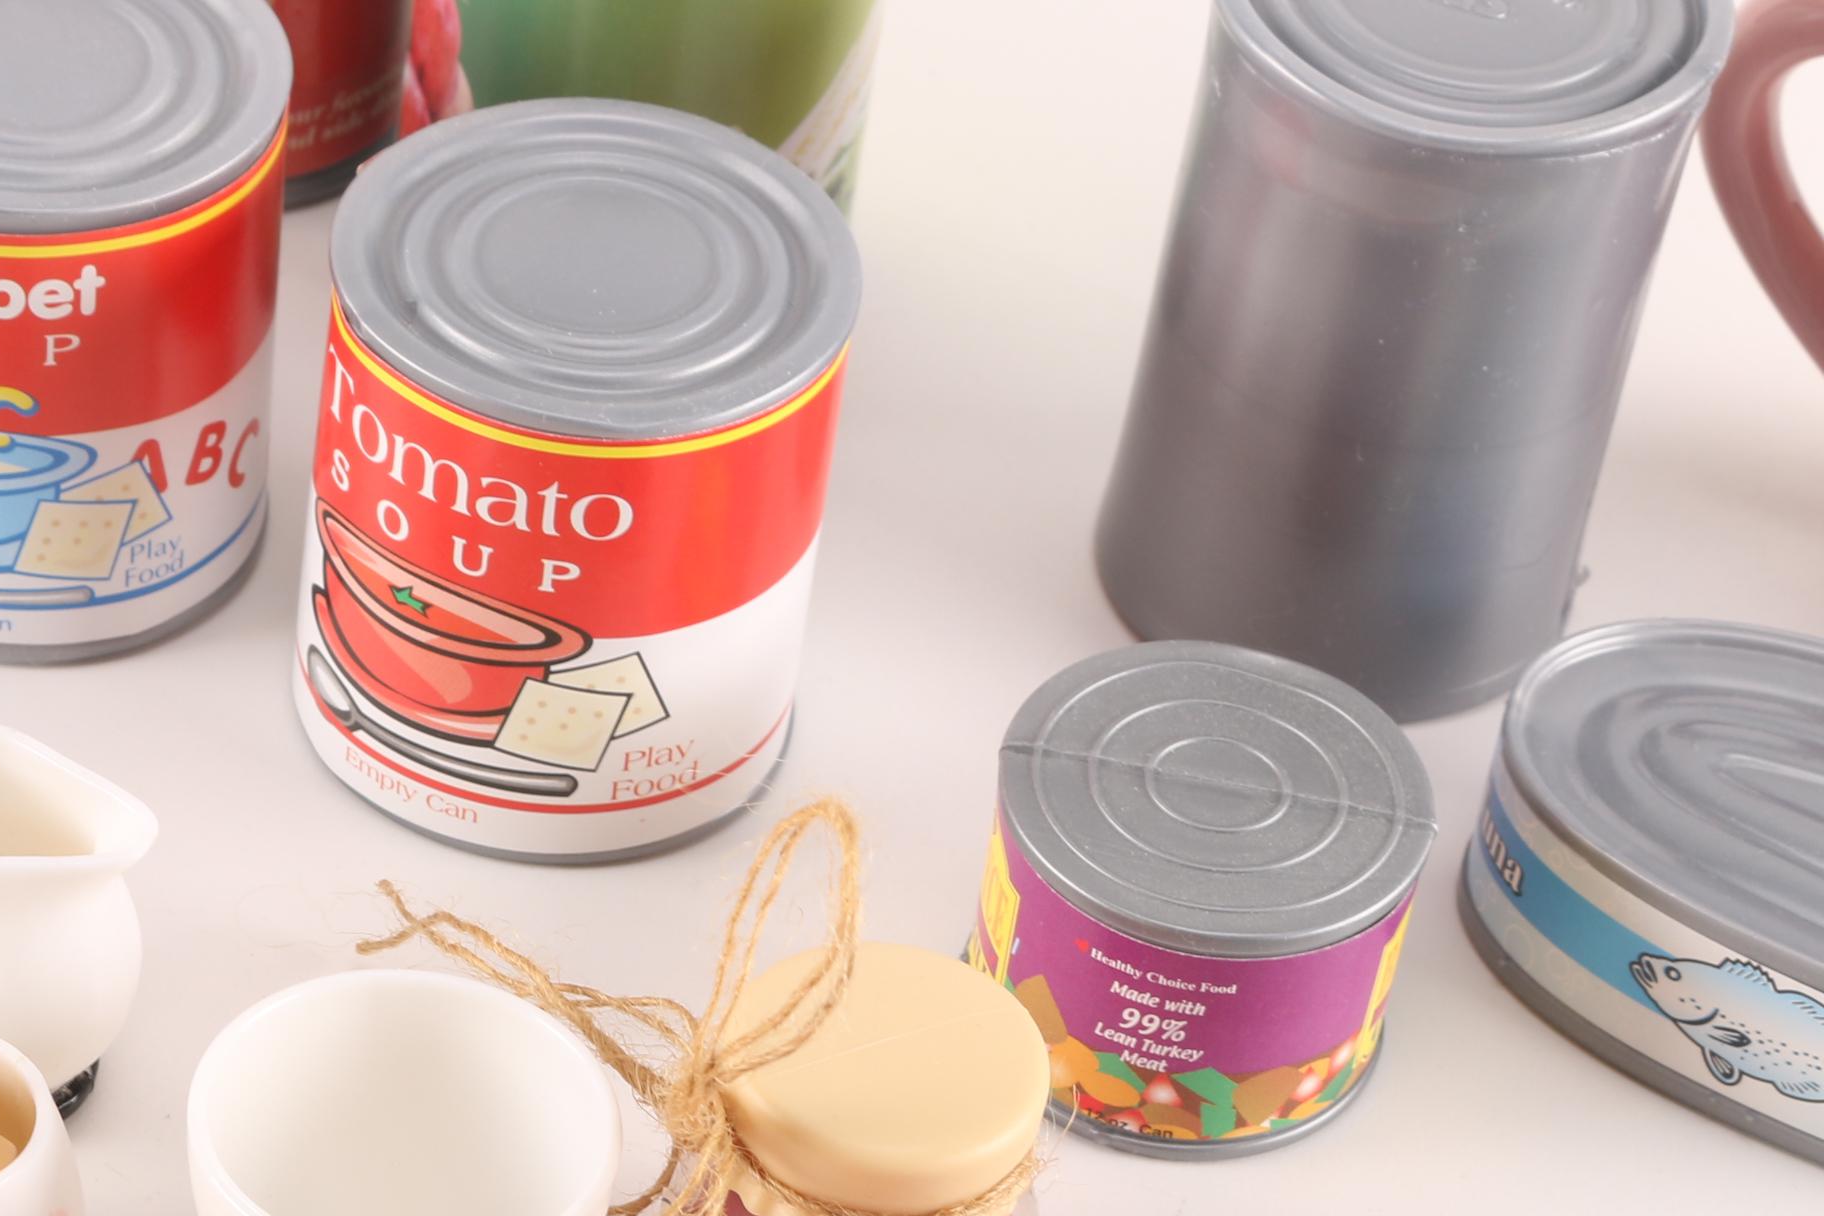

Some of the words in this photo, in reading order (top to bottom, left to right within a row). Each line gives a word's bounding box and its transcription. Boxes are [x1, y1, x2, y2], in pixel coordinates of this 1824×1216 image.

[129, 418, 260, 494] ABC
[328, 343, 634, 542] Tomato
[331, 448, 580, 593] SOUP
[124, 548, 185, 589] Food
[129, 533, 183, 565] Play
[621, 739, 696, 772] Play
[345, 746, 418, 803] Empty
[426, 793, 479, 824] Can
[610, 758, 700, 801] Food
[1482, 815, 1523, 894] una
[1090, 948, 1143, 980] Healthy
[1146, 971, 1196, 992] Choice
[1200, 982, 1237, 995] Food
[1110, 980, 1160, 1008] Made
[1164, 1000, 1206, 1016] with
[1094, 1021, 1137, 1048] Lean
[1141, 1038, 1204, 1062] Turkey
[1118, 1007, 1188, 1043] 99%
[1119, 1049, 1168, 1073] Meat
[1138, 1123, 1174, 1139] Can
